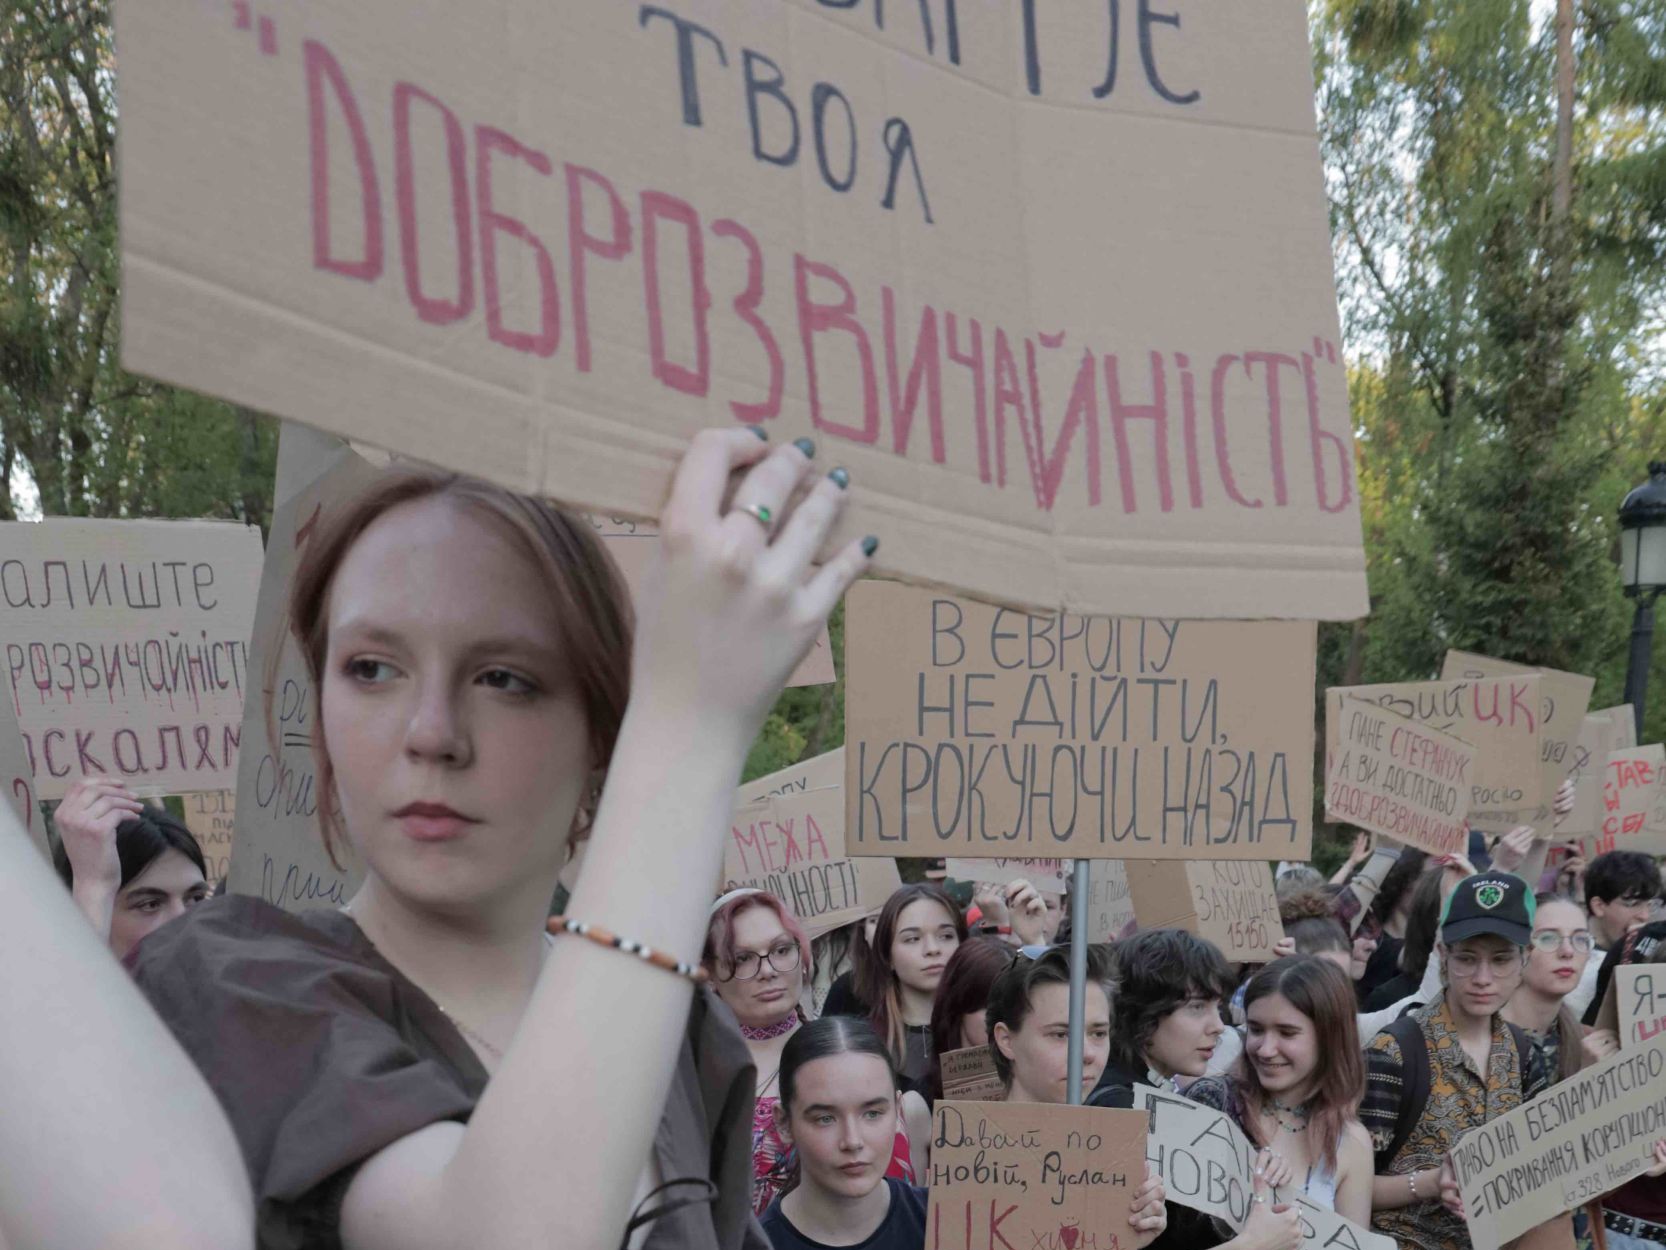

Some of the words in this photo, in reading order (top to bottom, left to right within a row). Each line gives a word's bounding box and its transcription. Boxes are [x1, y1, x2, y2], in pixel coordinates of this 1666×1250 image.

[639, 5, 934, 224] ТВОЯ
[931, 601, 965, 667] В
[990, 608, 1181, 673] ЄВРОПУ
[918, 672, 996, 738] НЕ
[1012, 671, 1228, 746] ДІЙТИ,
[1474, 683, 1534, 734] ЦК
[858, 741, 1150, 844] КРОКУЮЧИ
[1162, 747, 1297, 846] НАЗАД
[732, 814, 829, 874] МЕЖА
[934, 1106, 1040, 1149] Давай
[1067, 1131, 1102, 1151] по
[1495, 1120, 1520, 1158] НА
[1581, 1096, 1666, 1164] КОРУПЦІОН
[1041, 1151, 1126, 1205] Руслан
